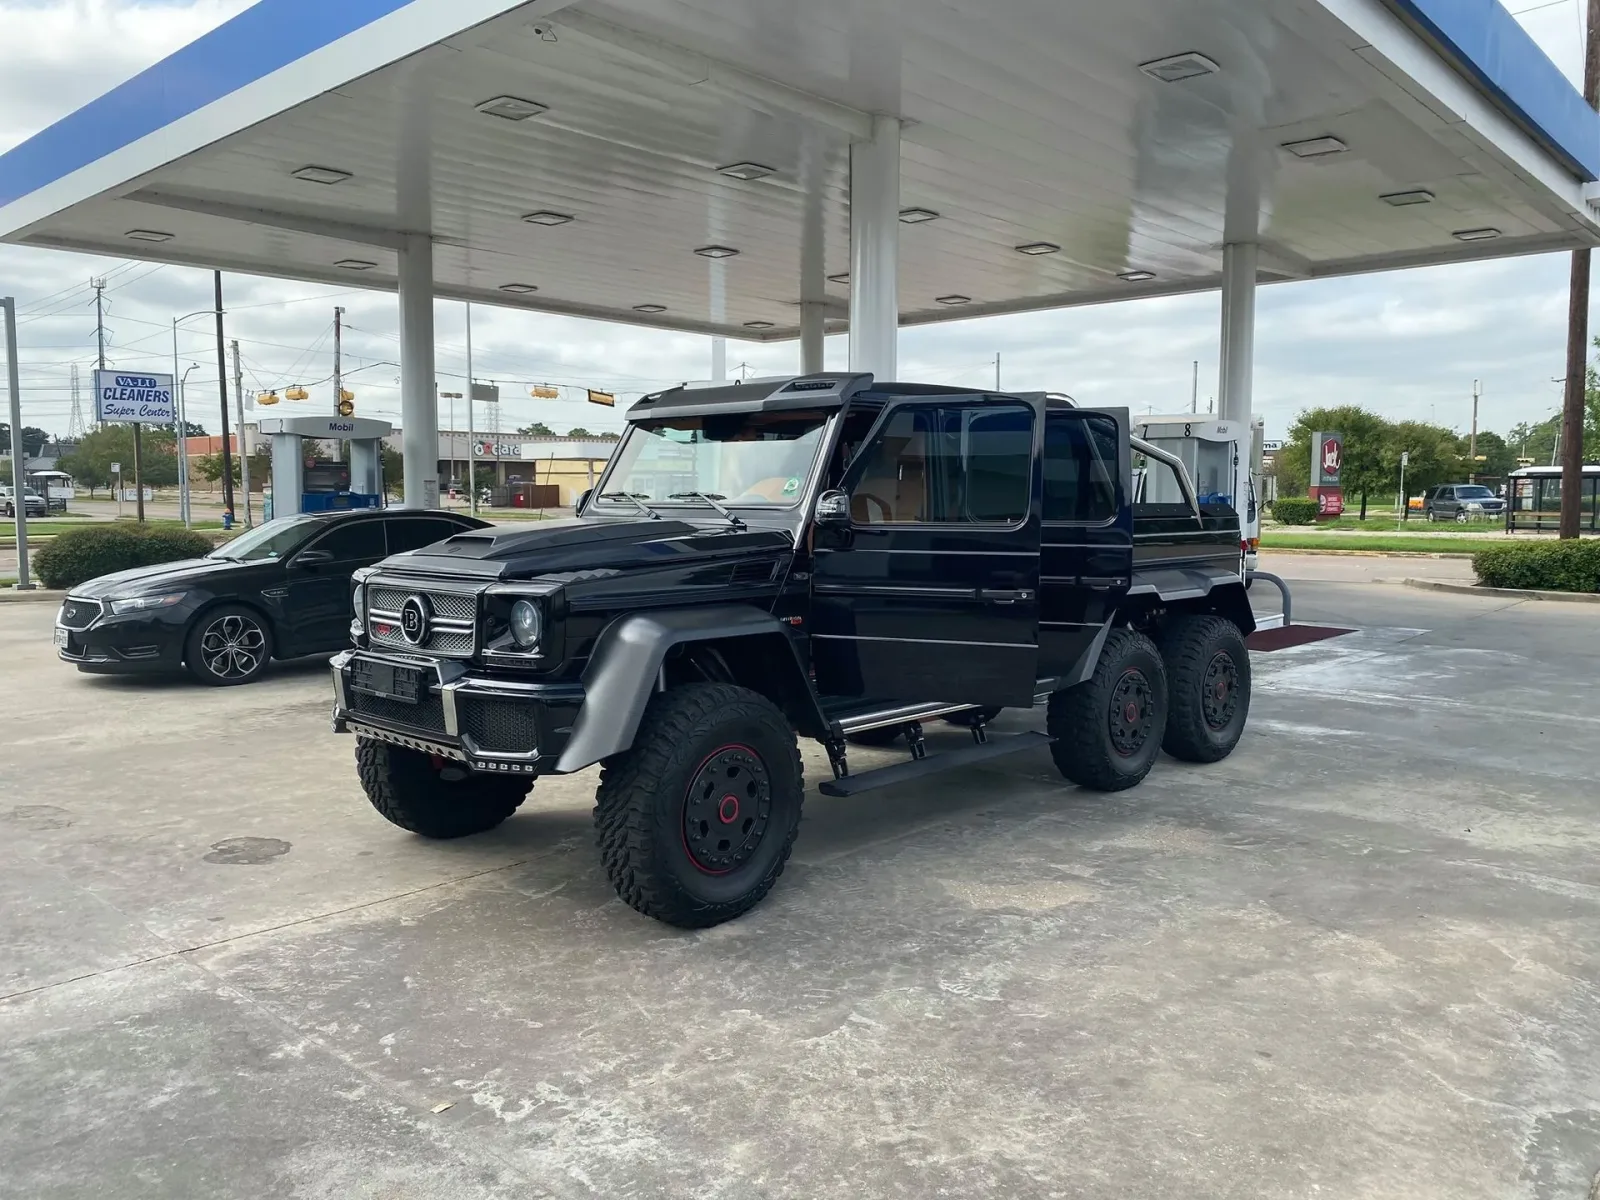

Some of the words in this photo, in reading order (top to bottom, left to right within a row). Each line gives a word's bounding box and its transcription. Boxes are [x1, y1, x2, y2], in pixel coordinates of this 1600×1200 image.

[117, 377, 155, 387] VA-LU
[103, 387, 170, 403] CLEANERS
[103, 403, 136, 418] Super
[139, 404, 171, 417] Center
[328, 422, 354, 432] Mobil
[1142, 424, 1149, 439] 7
[1184, 423, 1191, 437] 8
[1323, 442, 1341, 469] Jack
[405, 608, 418, 632] B
